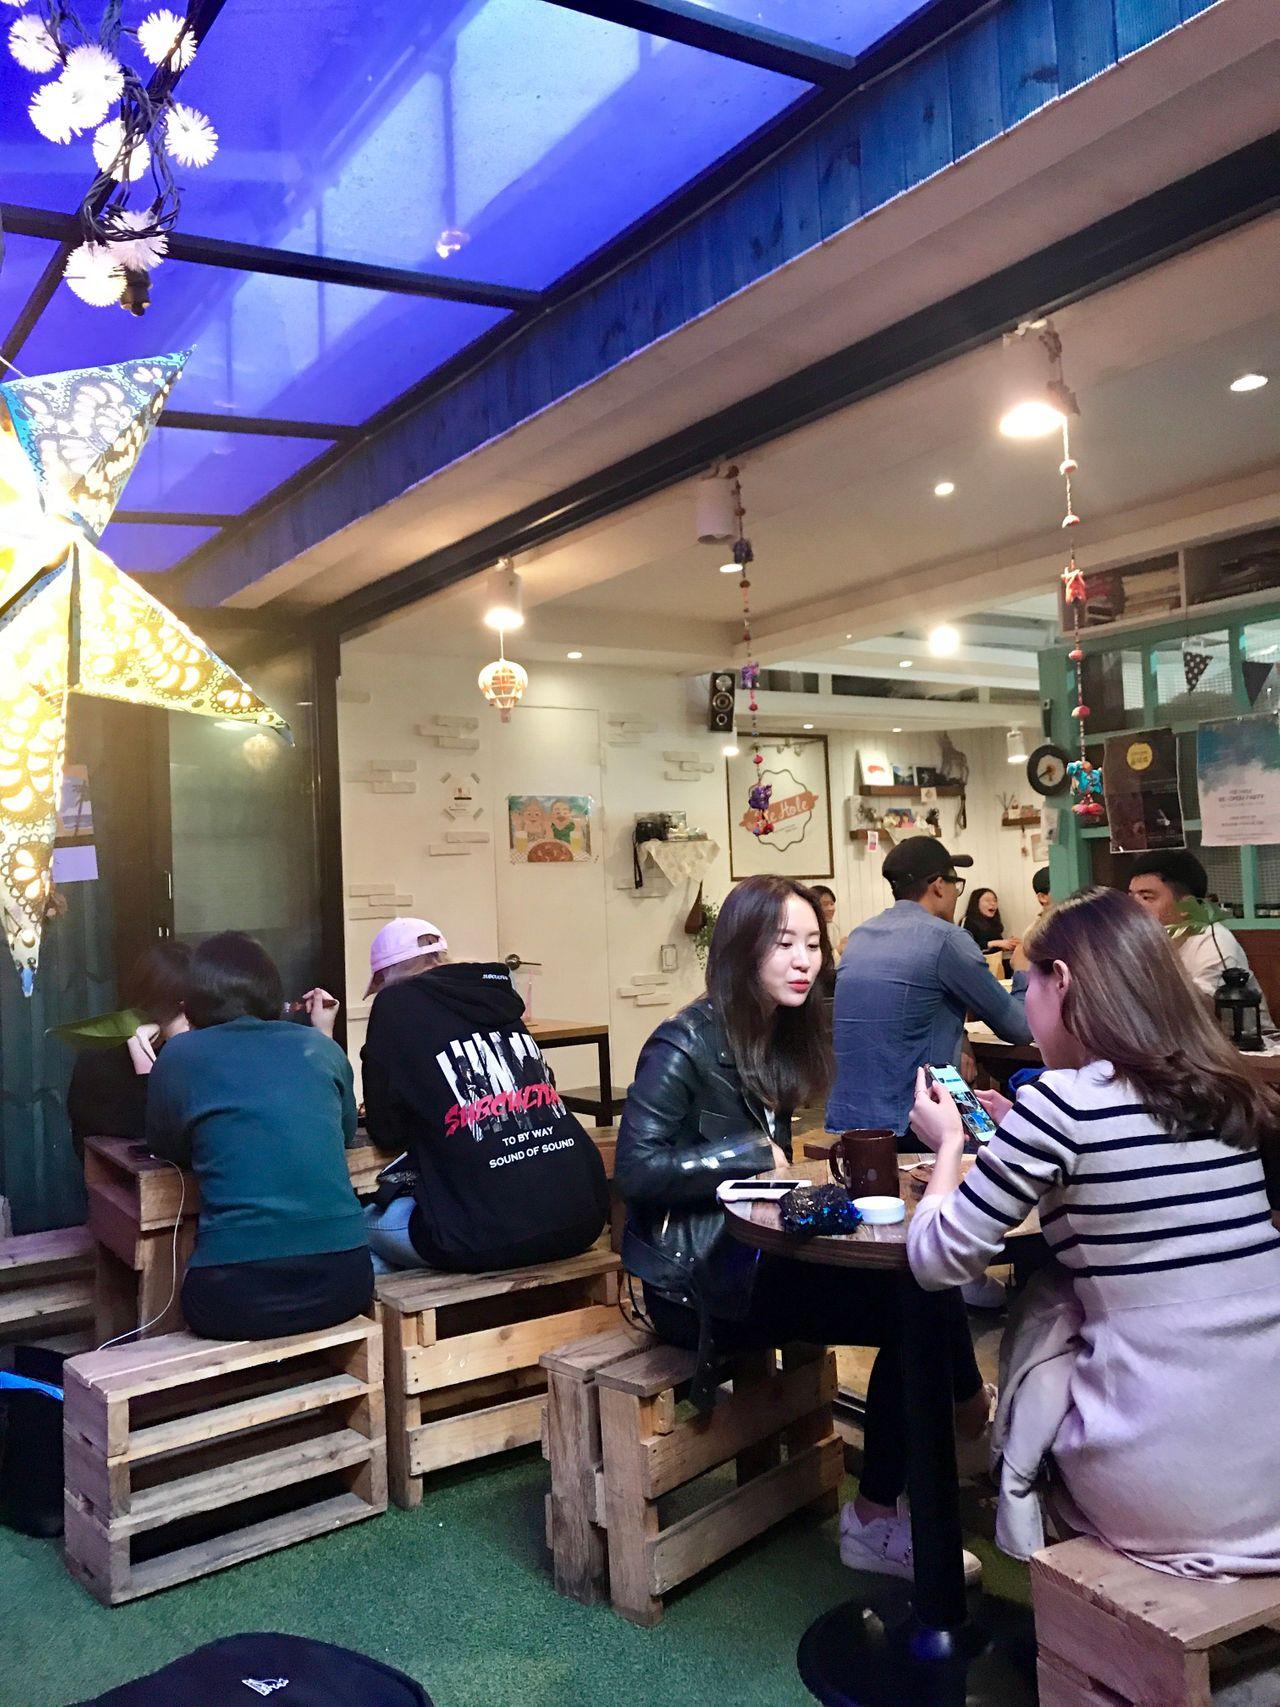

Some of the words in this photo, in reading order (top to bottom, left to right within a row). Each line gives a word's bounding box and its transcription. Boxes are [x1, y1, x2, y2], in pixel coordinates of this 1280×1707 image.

[778, 796, 808, 819] Hole
[502, 1137, 517, 1147] TO
[517, 1131, 530, 1143] BY
[532, 1126, 554, 1139] WAY
[489, 1150, 525, 1169] SOUND
[526, 1146, 540, 1157] OF
[541, 1138, 575, 1153] SOUND
